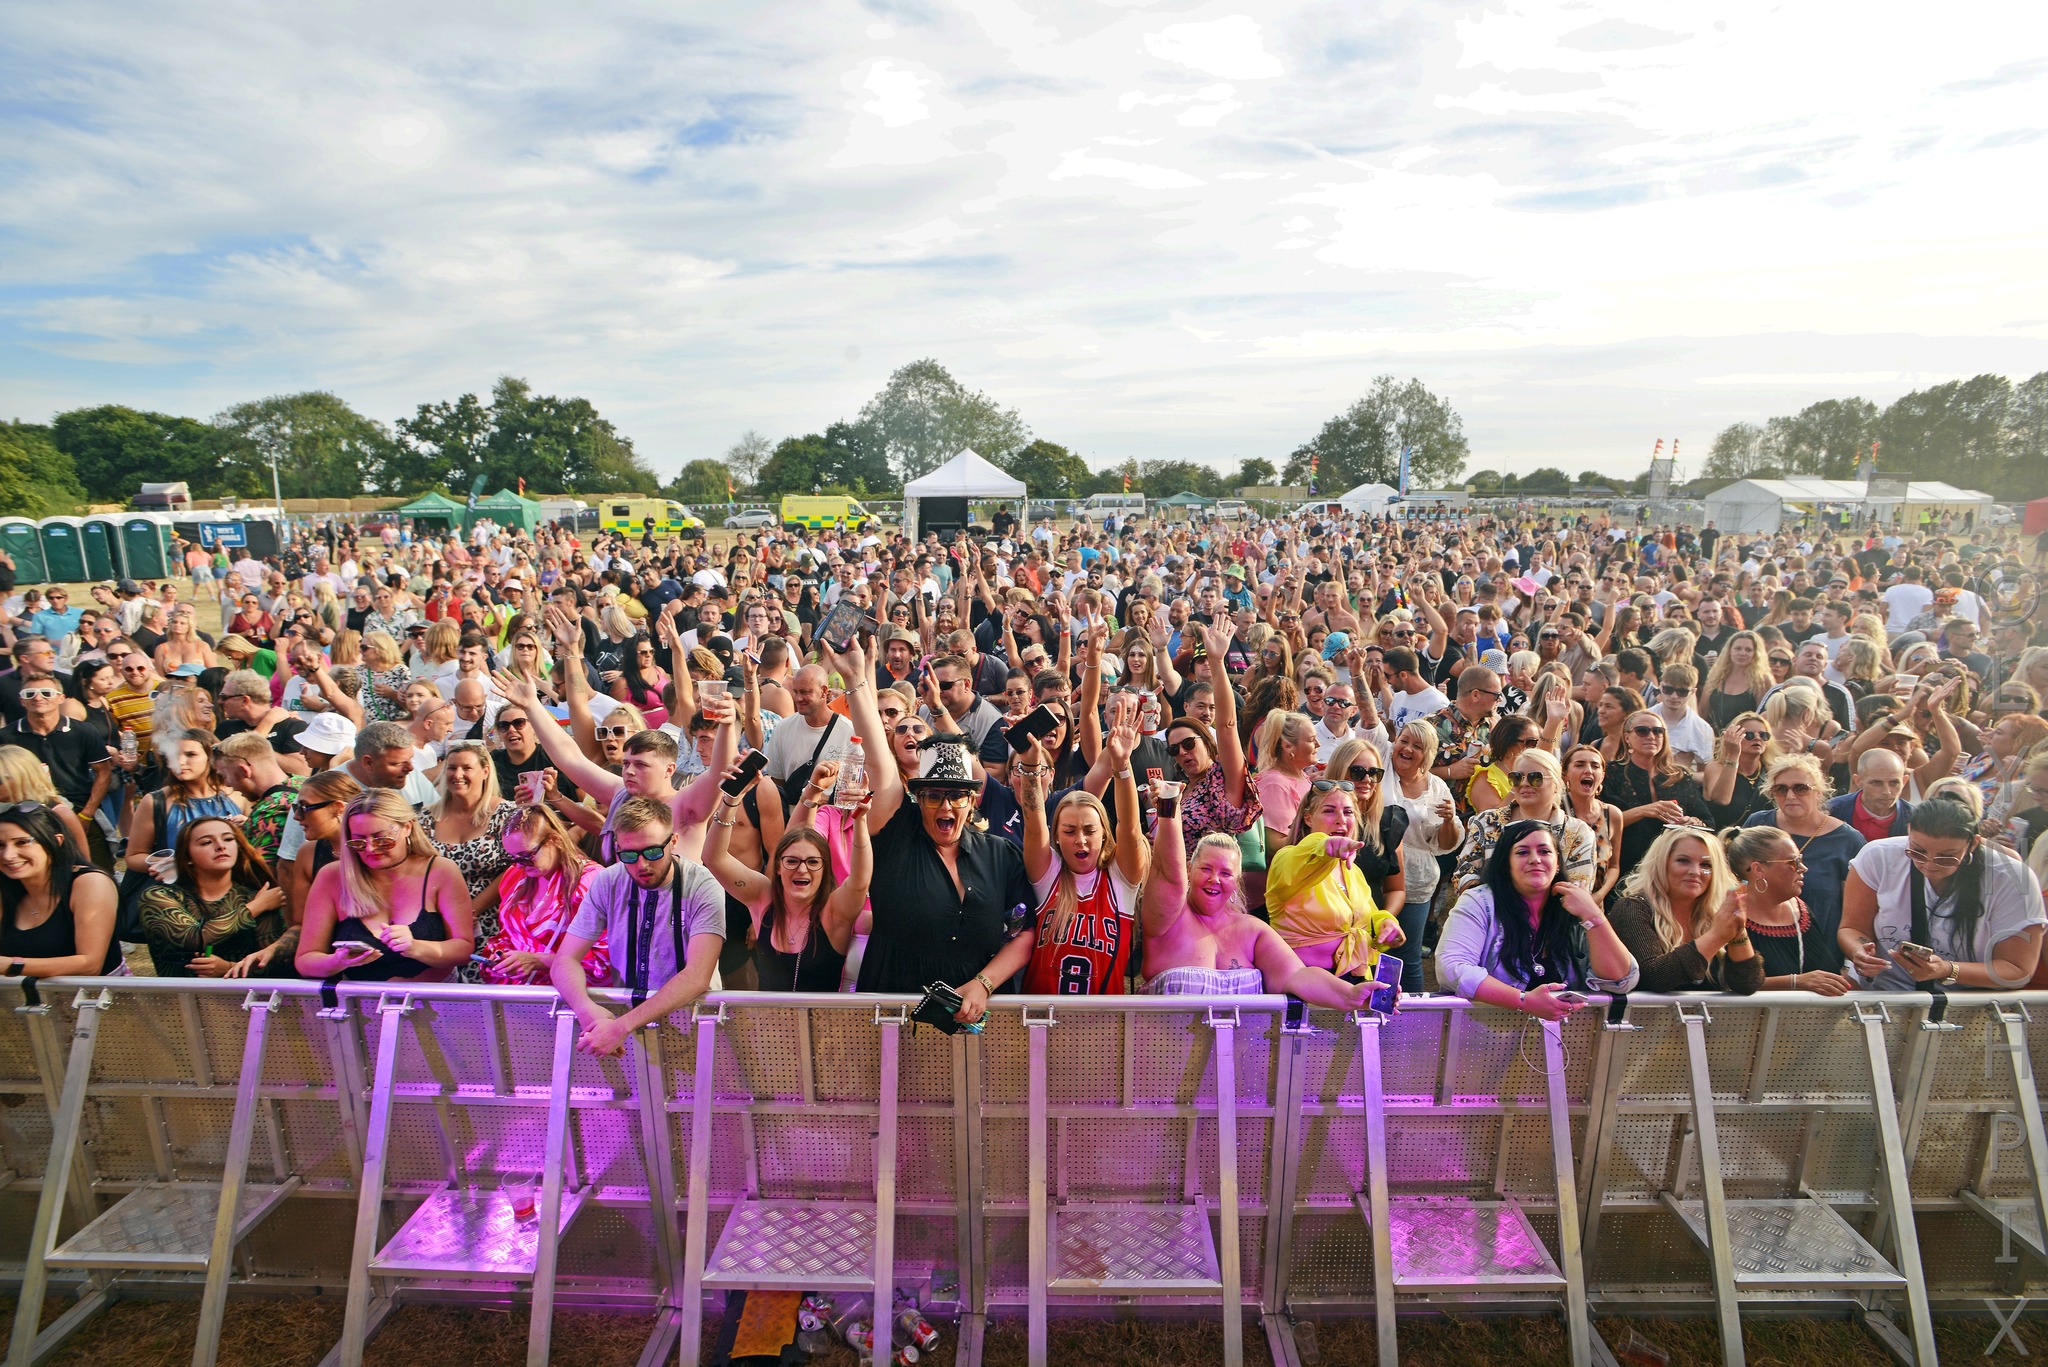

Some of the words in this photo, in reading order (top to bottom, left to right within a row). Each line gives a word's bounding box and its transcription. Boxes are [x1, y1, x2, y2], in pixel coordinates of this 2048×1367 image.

[936, 764, 964, 775] DANCE
[1037, 909, 1118, 957] BULLS
[1058, 954, 1092, 995] 8
